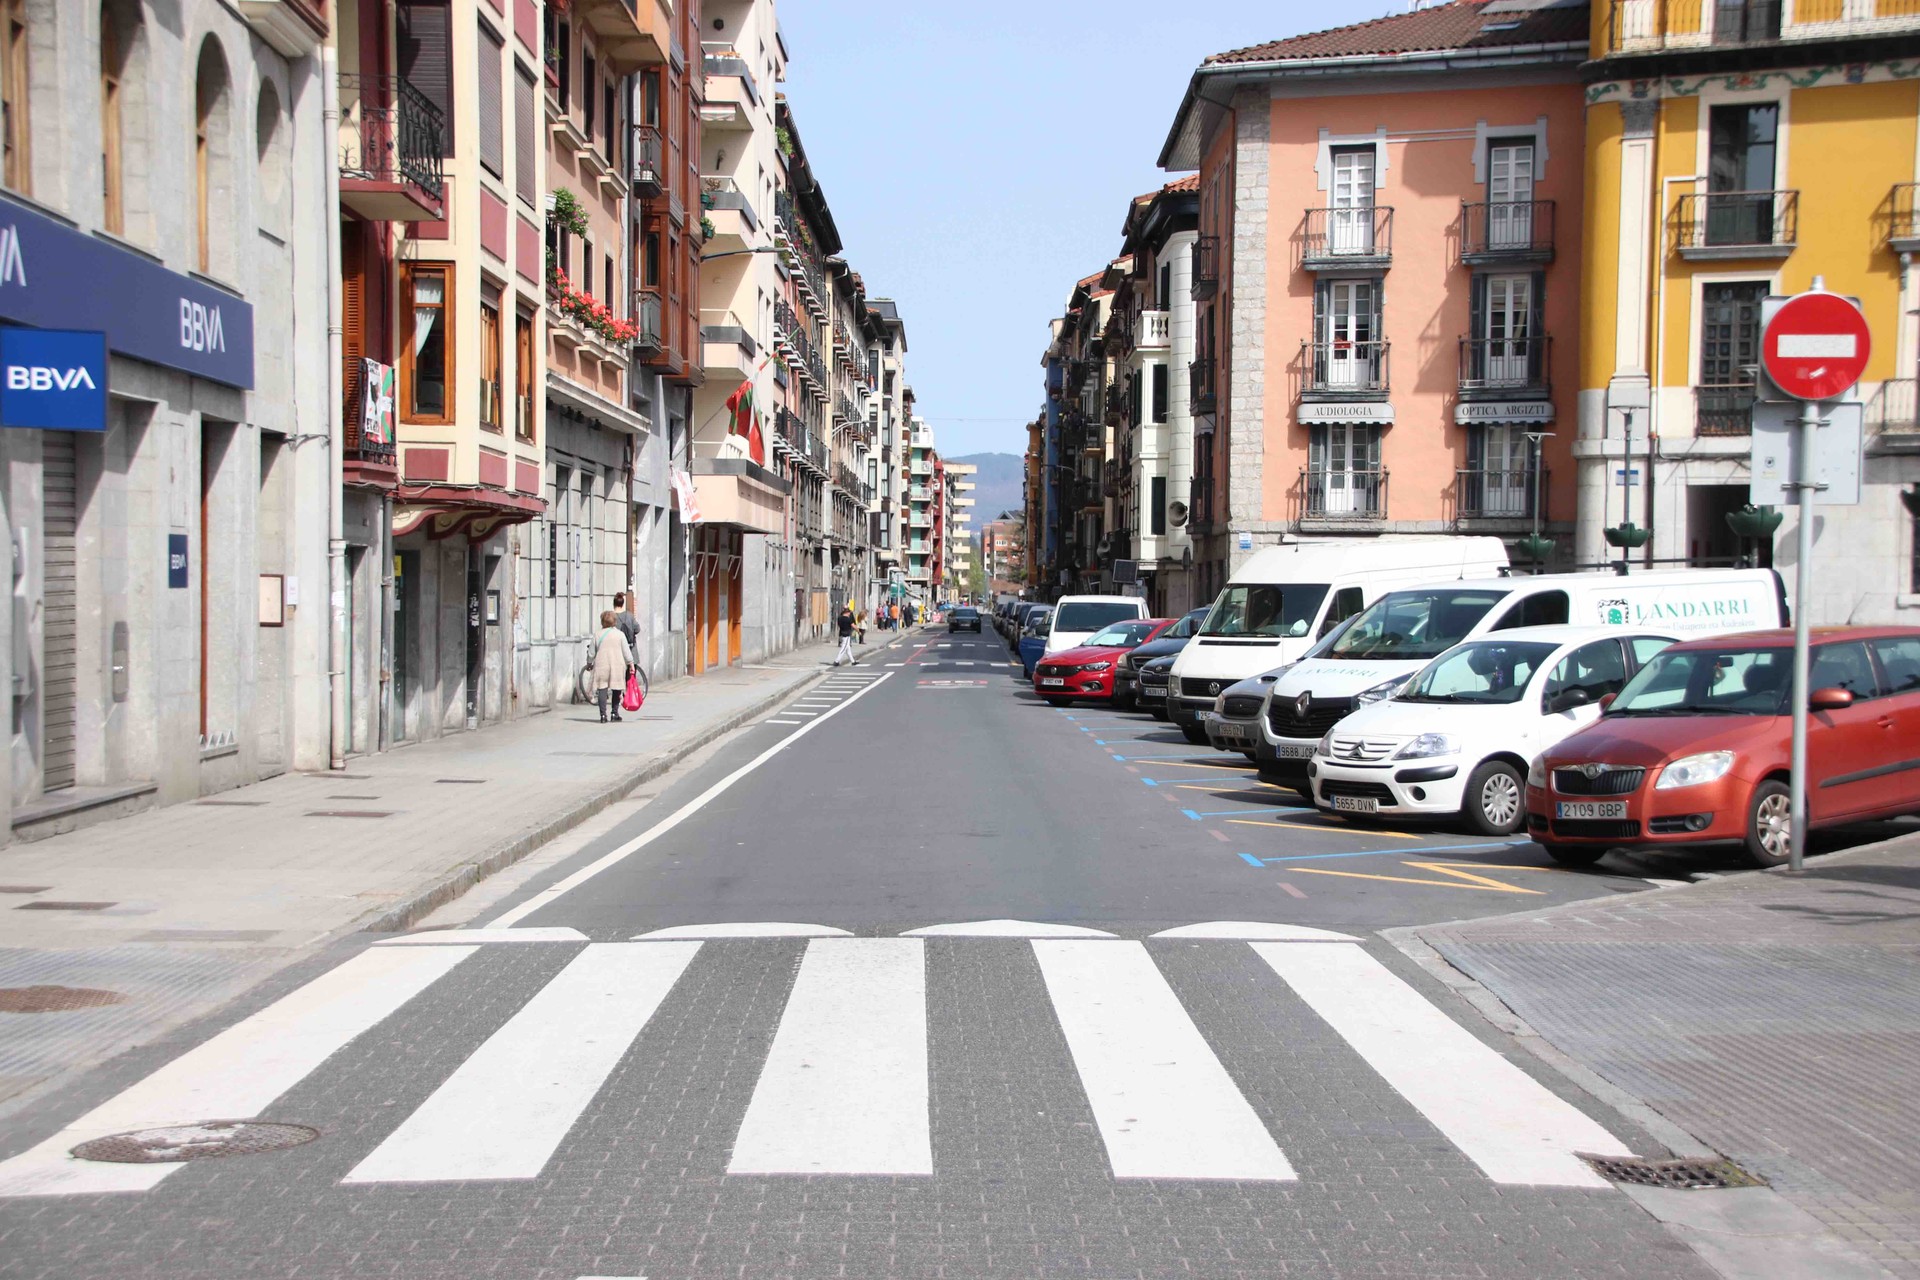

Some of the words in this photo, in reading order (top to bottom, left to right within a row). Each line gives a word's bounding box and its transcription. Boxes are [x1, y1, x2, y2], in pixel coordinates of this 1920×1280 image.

[180, 297, 226, 354] BBVA
[7, 365, 96, 391] BBVA
[1314, 406, 1373, 416] AUDIOLOGIA
[1462, 406, 1498, 416] OPTICA
[1504, 404, 1546, 415] ARGIZTI
[171, 553, 187, 570] BBVA
[1636, 599, 1749, 620] LANDARRI
[1336, 797, 1356, 810] 5655
[1357, 799, 1374, 811] DVN
[1564, 803, 1594, 817] 2109
[1598, 803, 1622, 817] GBP
